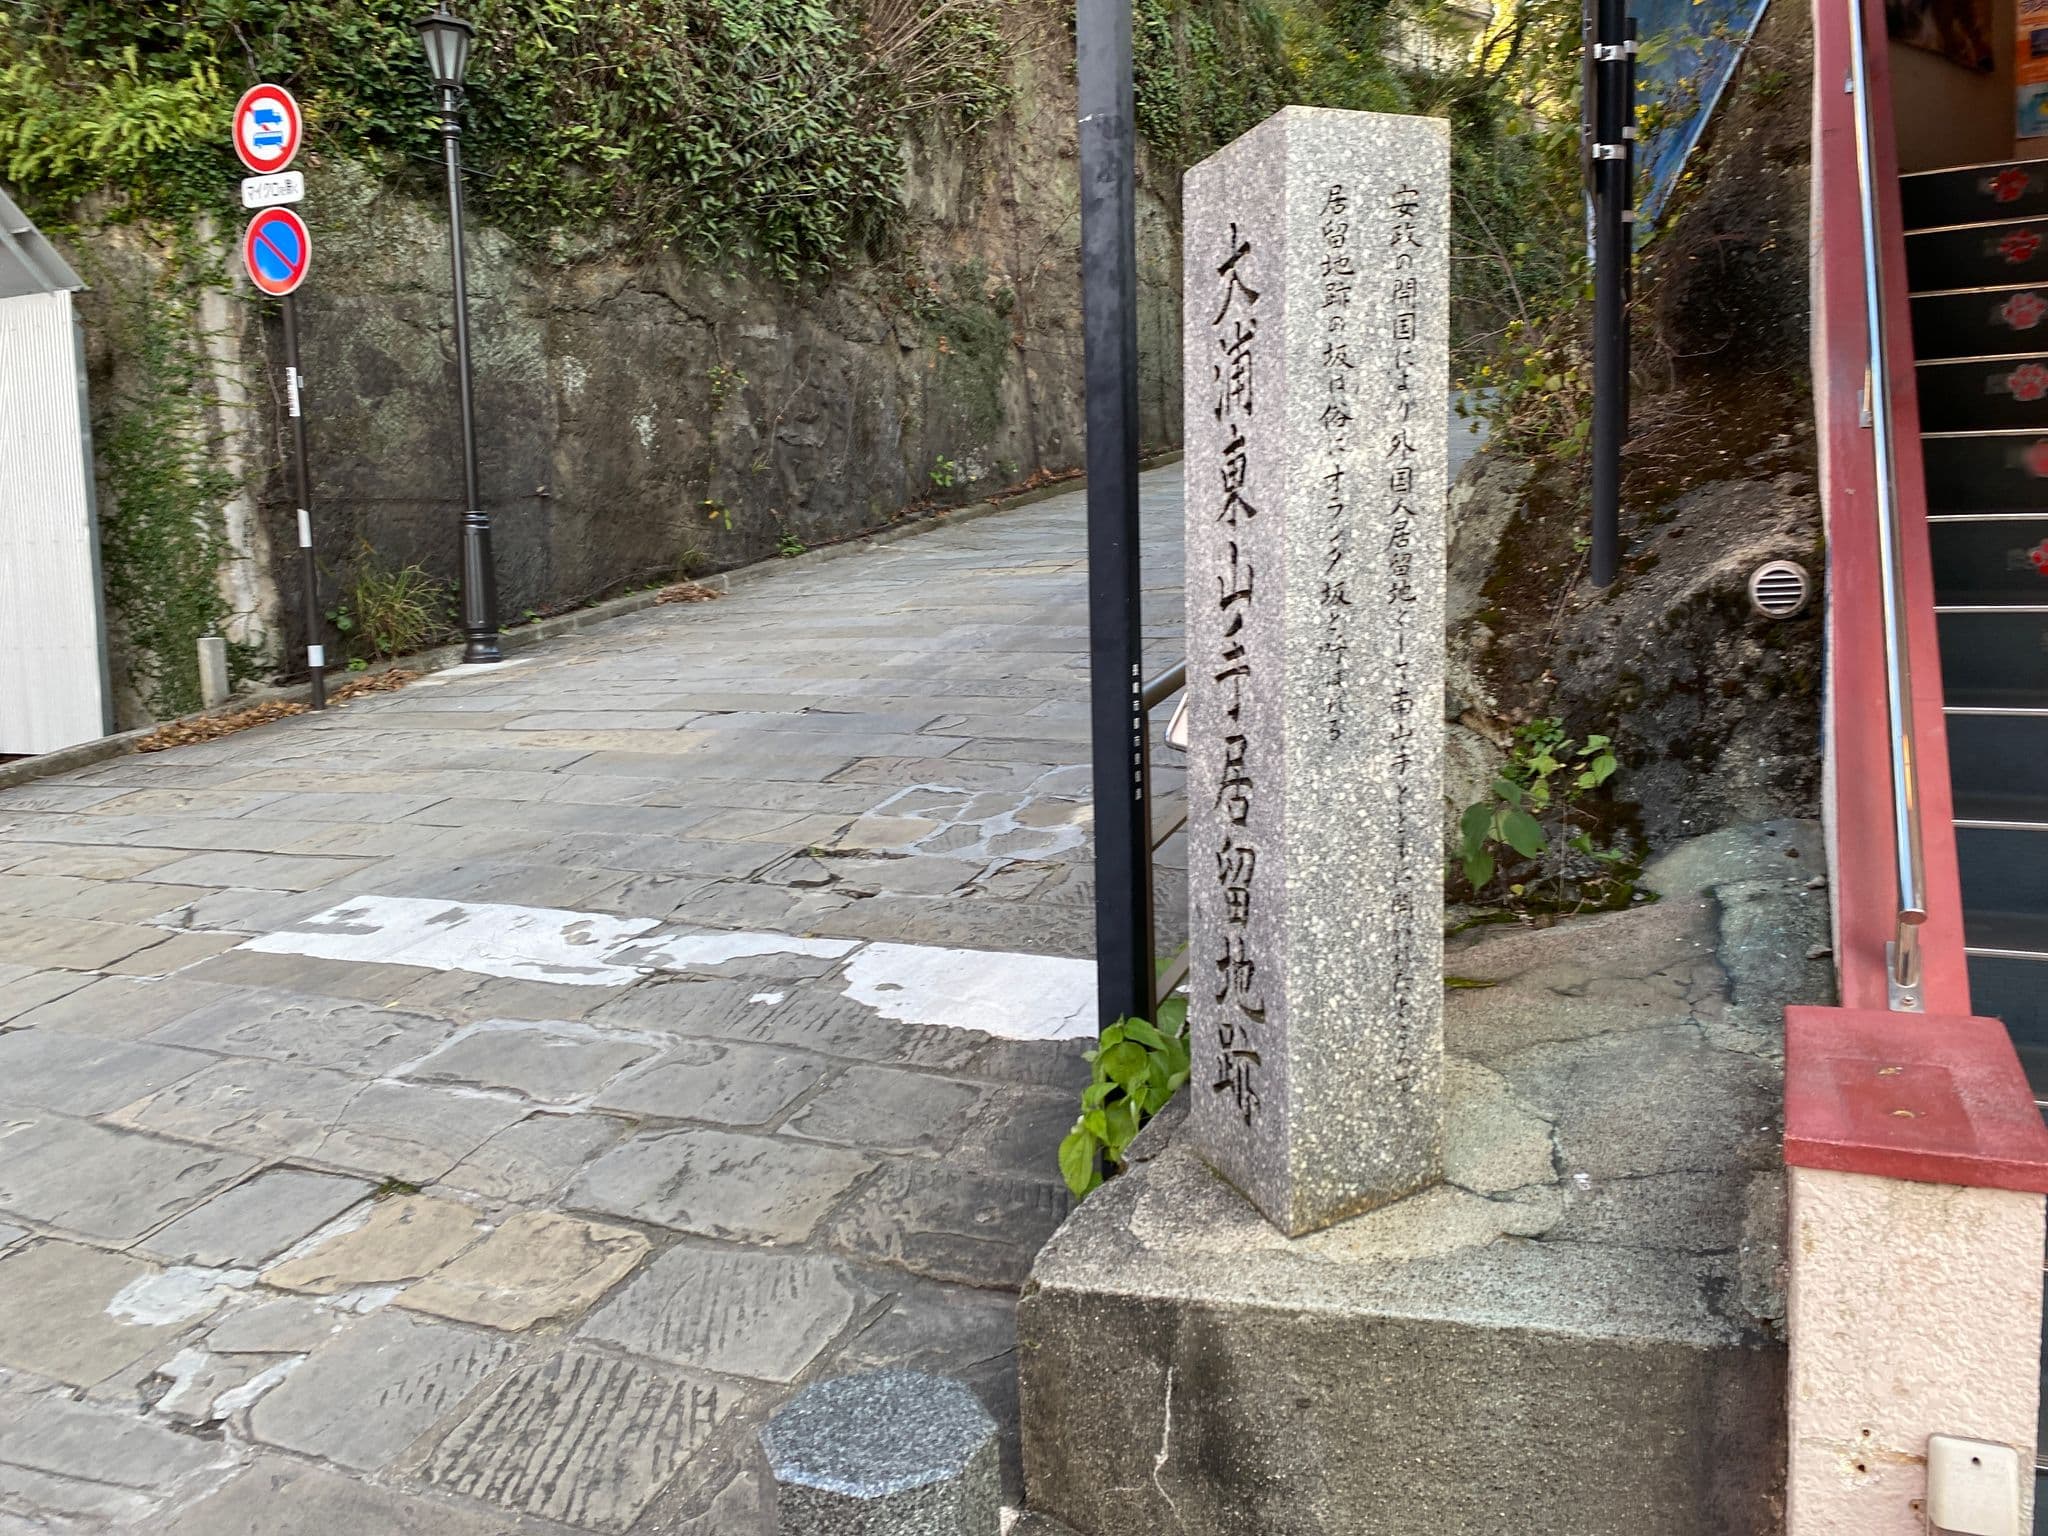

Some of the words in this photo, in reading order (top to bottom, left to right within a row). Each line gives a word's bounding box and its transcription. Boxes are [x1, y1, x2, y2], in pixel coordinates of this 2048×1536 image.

[1212, 222, 1266, 1126] 大浦東山手居留地跡
